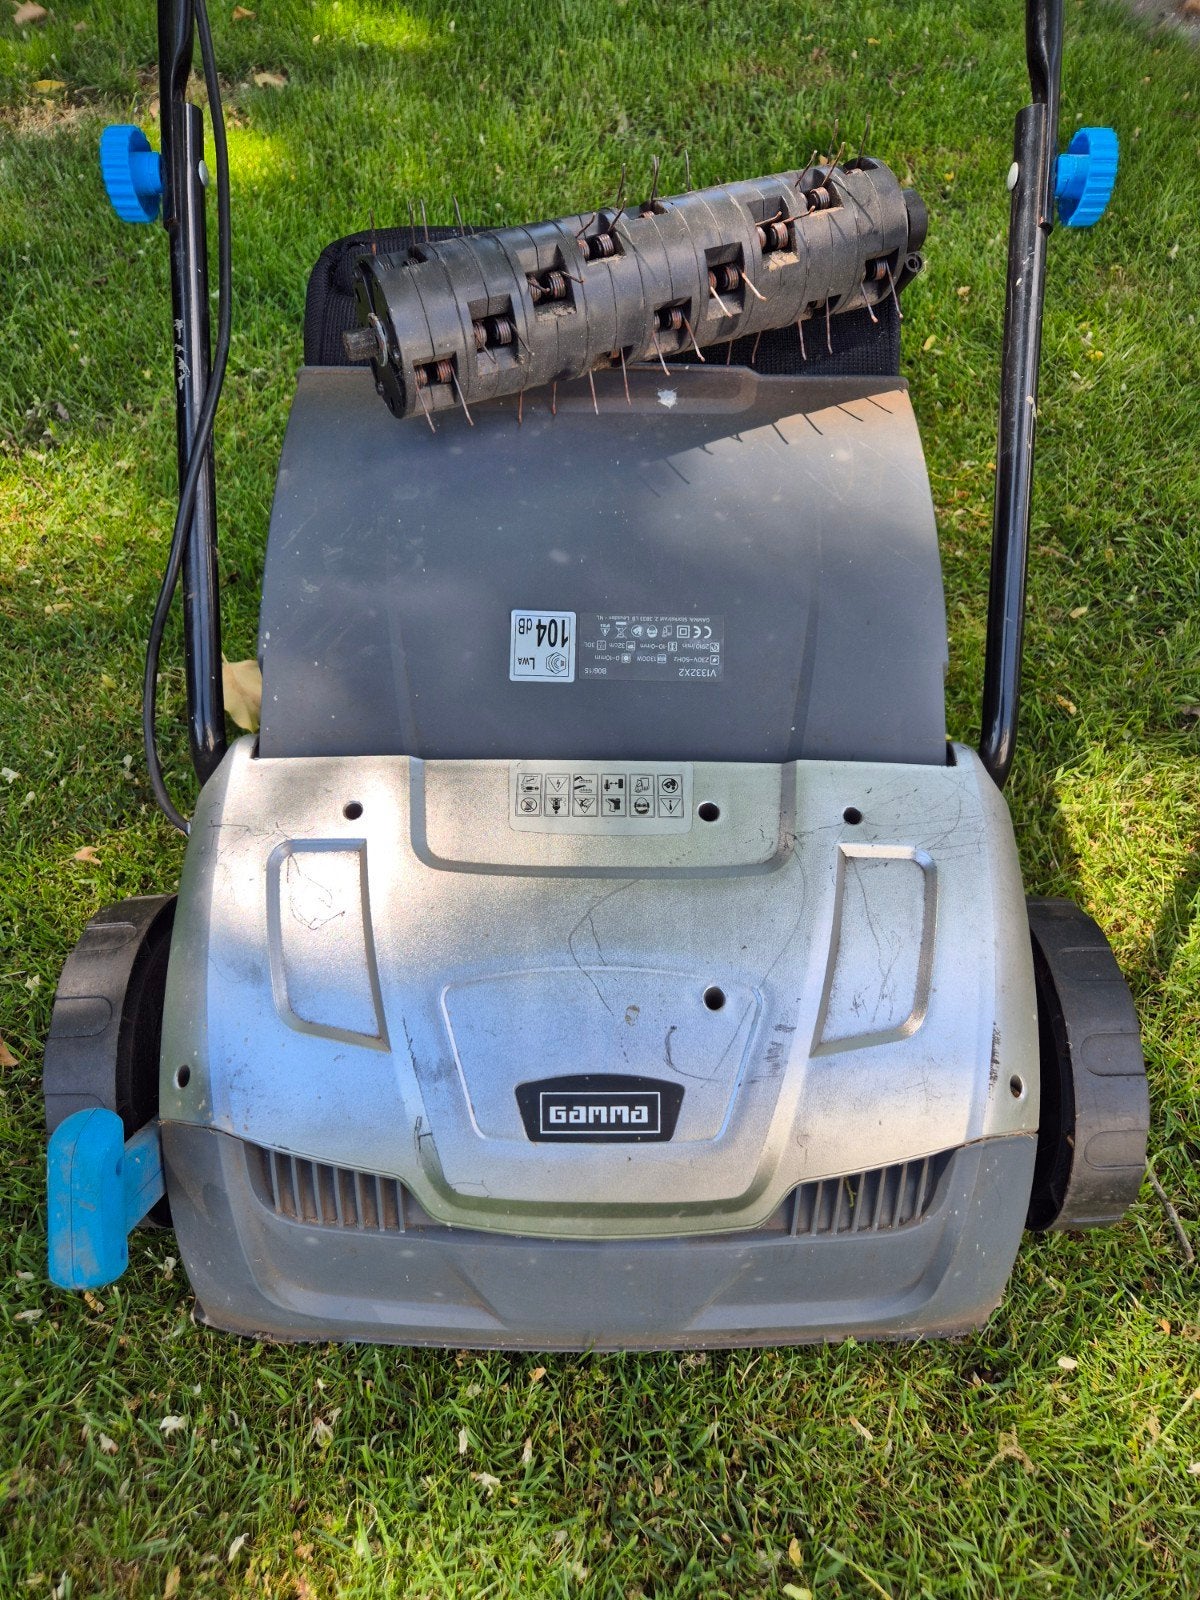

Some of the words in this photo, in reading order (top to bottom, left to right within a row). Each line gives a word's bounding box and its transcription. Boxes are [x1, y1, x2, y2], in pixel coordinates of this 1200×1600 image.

[518, 618, 532, 635] dB
[536, 618, 569, 648] 104
[679, 668, 716, 677] V1332X2
[549, 1106, 649, 1124] GAMMA
